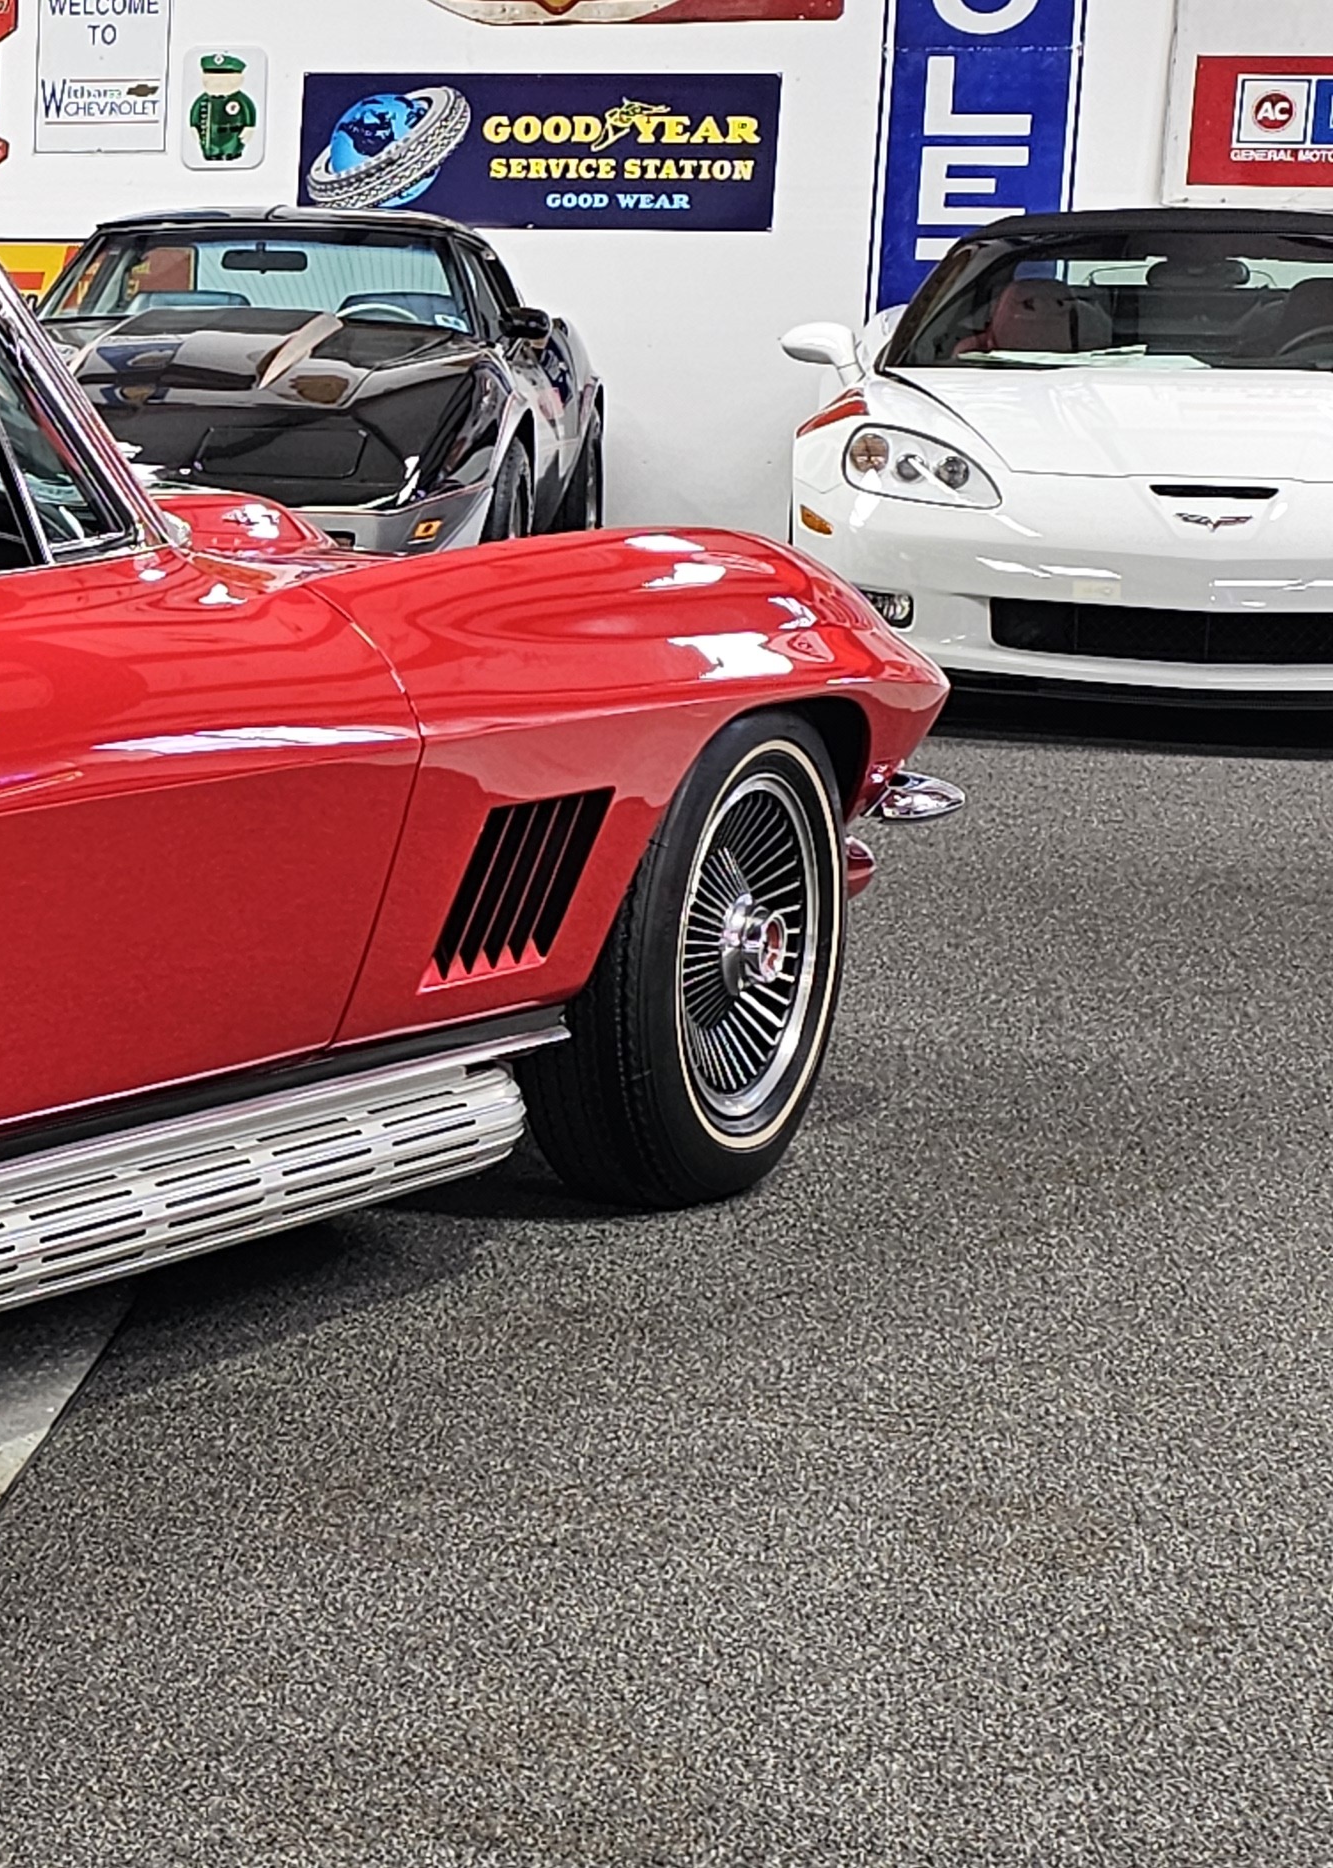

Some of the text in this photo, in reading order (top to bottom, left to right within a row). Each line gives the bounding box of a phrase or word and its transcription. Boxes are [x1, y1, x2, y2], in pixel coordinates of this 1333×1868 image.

[48, 0, 159, 15] WELCOME
[87, 24, 117, 45] TO
[64, 100, 160, 116] CHEVROLET
[1257, 101, 1290, 121] AC
[1230, 149, 1295, 161] GENERAL
[490, 159, 754, 180] SERVICE STATION
[546, 193, 690, 210] GOOD WEAR
